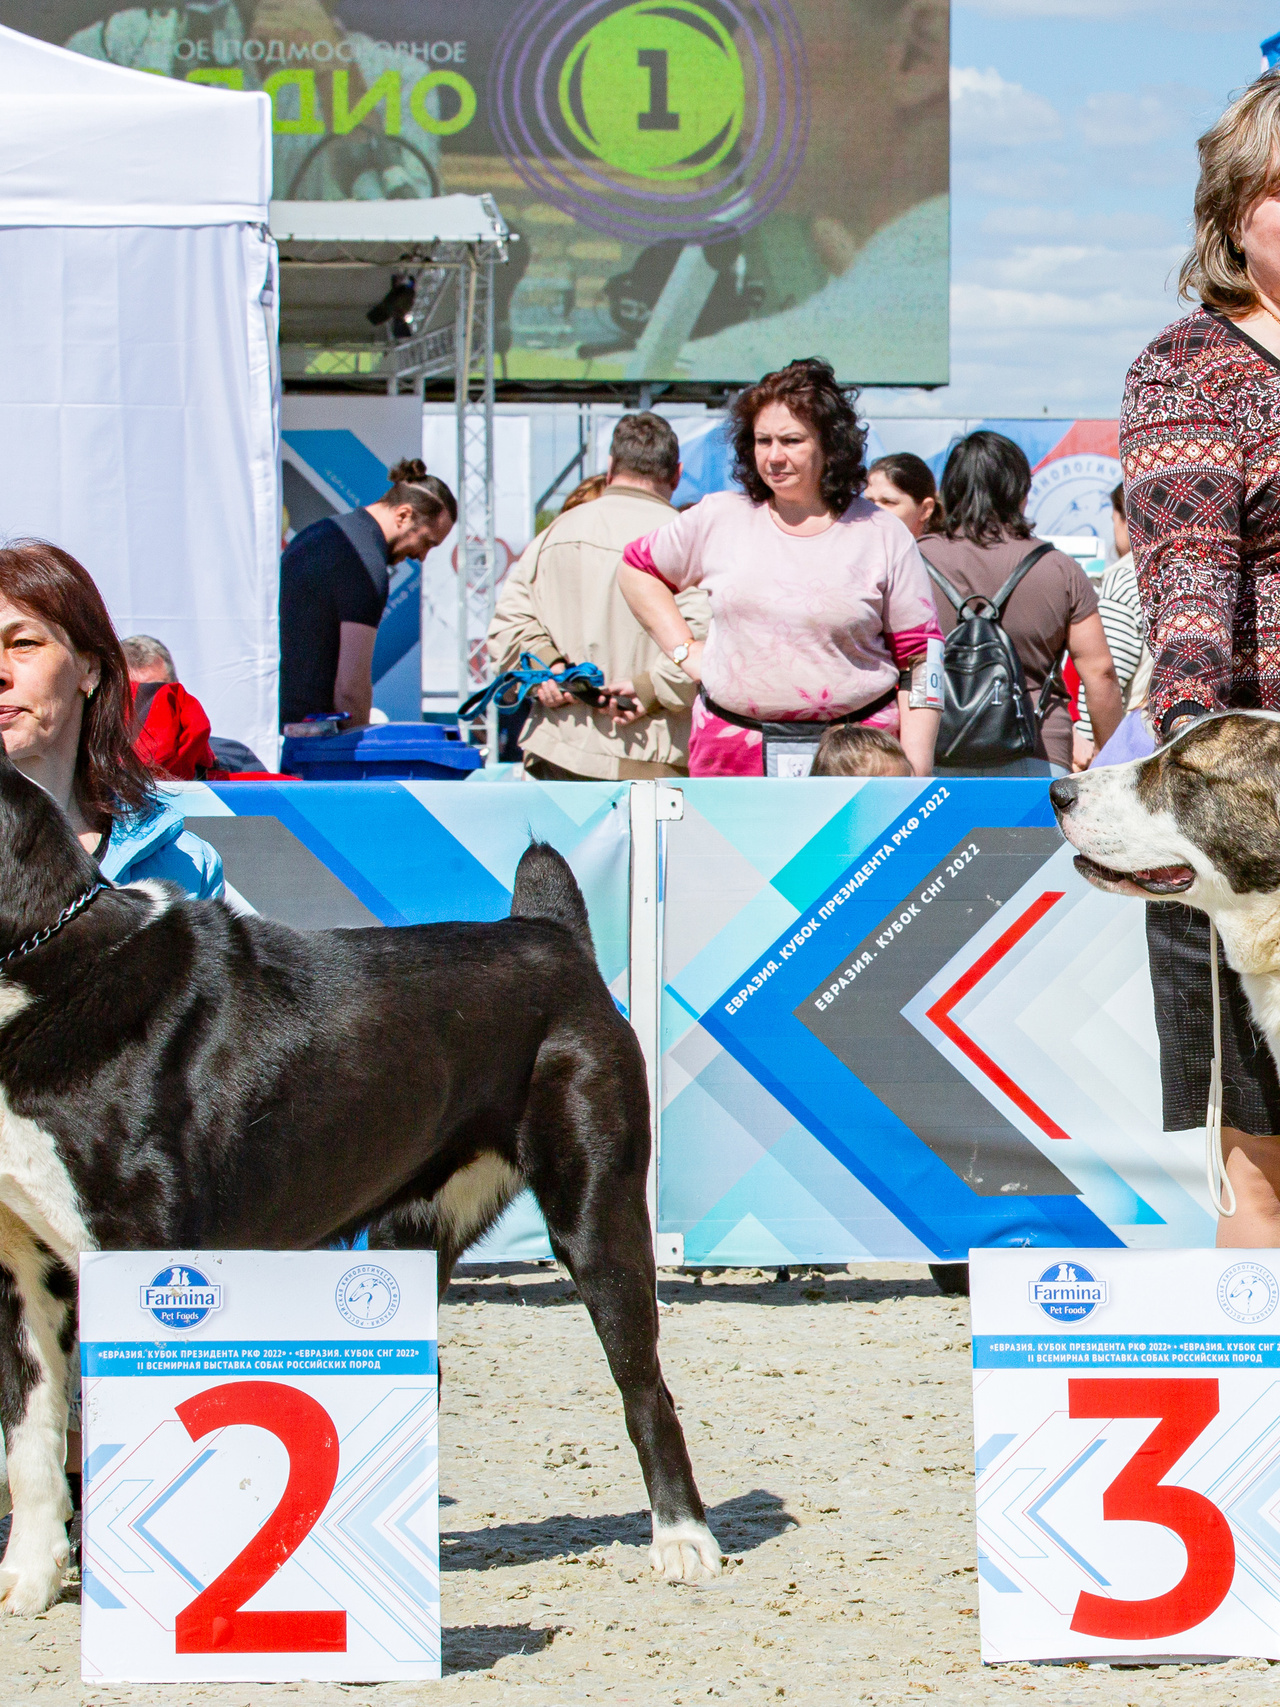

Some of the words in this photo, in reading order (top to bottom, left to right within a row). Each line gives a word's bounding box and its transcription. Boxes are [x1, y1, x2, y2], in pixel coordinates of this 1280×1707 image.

[637, 50, 680, 131] 1
[134, 67, 477, 135] ДИО
[724, 959, 783, 1016] ЕВРАЗИЯ.
[779, 917, 822, 961] КУБОК
[817, 844, 896, 920] ПРЕЗИДЕНТА
[891, 818, 920, 846] РКФ
[918, 786, 951, 820] 2022
[814, 950, 878, 1012] ЕВРАЗИЯ.
[876, 903, 921, 950] КУБОК
[920, 875, 947, 904] СНГ
[945, 843, 981, 878] 2022
[145, 1289, 215, 1306] Farmina
[1034, 1284, 1101, 1300] Farmina
[162, 1312, 174, 1320] Pet
[176, 1312, 199, 1320] Foods
[1050, 1306, 1062, 1314] Pet
[1064, 1306, 1086, 1314] Foods
[148, 1350, 178, 1359] КУБОК
[180, 1350, 240, 1359] ПРЕЗИДЕНТА
[242, 1350, 260, 1358] РКФ
[344, 1349, 374, 1357] КУБОК
[377, 1349, 393, 1357] СНГ
[1038, 1343, 1066, 1351] КУБОК
[1070, 1343, 1126, 1351] ПРЕЗИДЕНТА
[1129, 1343, 1146, 1351] РКФ
[1227, 1343, 1255, 1351] КУБОК
[1258, 1343, 1273, 1351] СНГ
[137, 1362, 144, 1370] II
[146, 1362, 200, 1370] ВСЕМИРНАЯ
[204, 1361, 251, 1369] ВЫСТАВКА
[254, 1361, 283, 1369] СОБАК
[287, 1359, 347, 1369] РОССИЙСКИХ
[350, 1360, 381, 1369] ПОРОД
[1028, 1354, 1034, 1362] II
[1037, 1354, 1089, 1362] ВСЕМИРНАЯ
[1092, 1354, 1138, 1362] ВЫСТАВКА
[1141, 1354, 1169, 1362] СОБАК
[1172, 1353, 1230, 1362] РОССИЙСКИХ
[1232, 1354, 1262, 1362] ПОРОД
[174, 1380, 347, 1654] 2
[1068, 1378, 1236, 1640] 3
